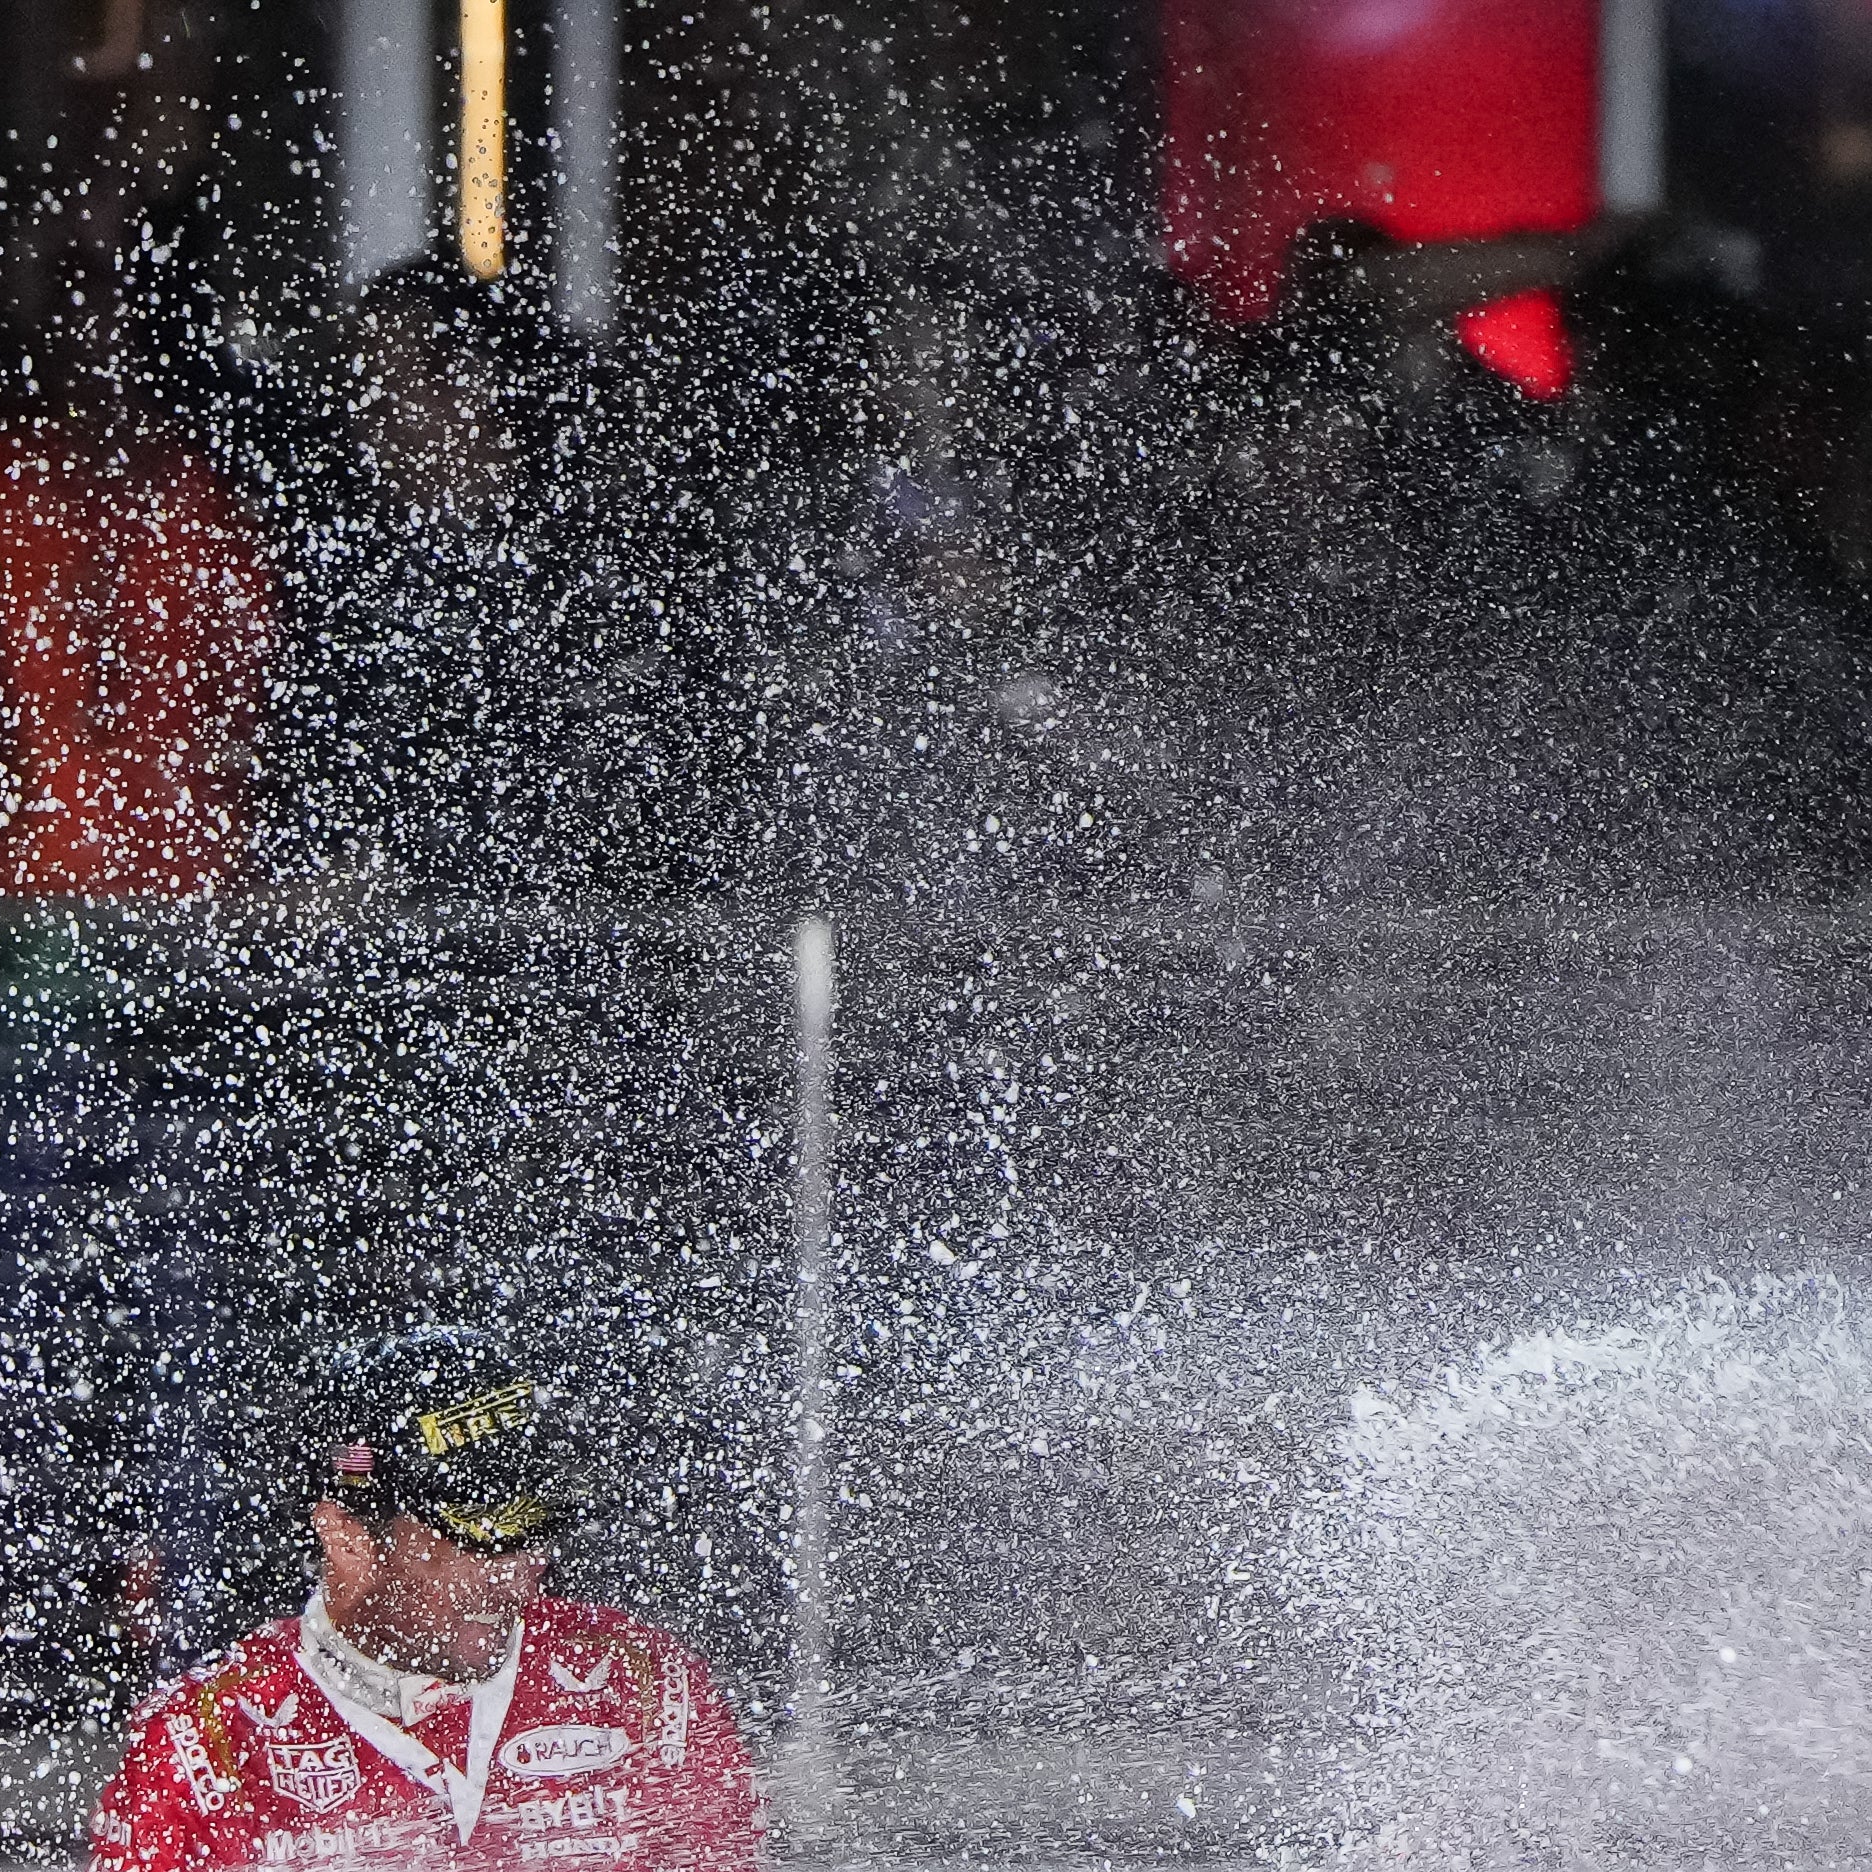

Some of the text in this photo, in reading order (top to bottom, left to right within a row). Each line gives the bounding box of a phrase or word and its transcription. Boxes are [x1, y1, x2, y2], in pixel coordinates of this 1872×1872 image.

[274, 1747, 351, 1772] TAG
[536, 1738, 611, 1762] RAUCH
[278, 1772, 359, 1800] HEUER
